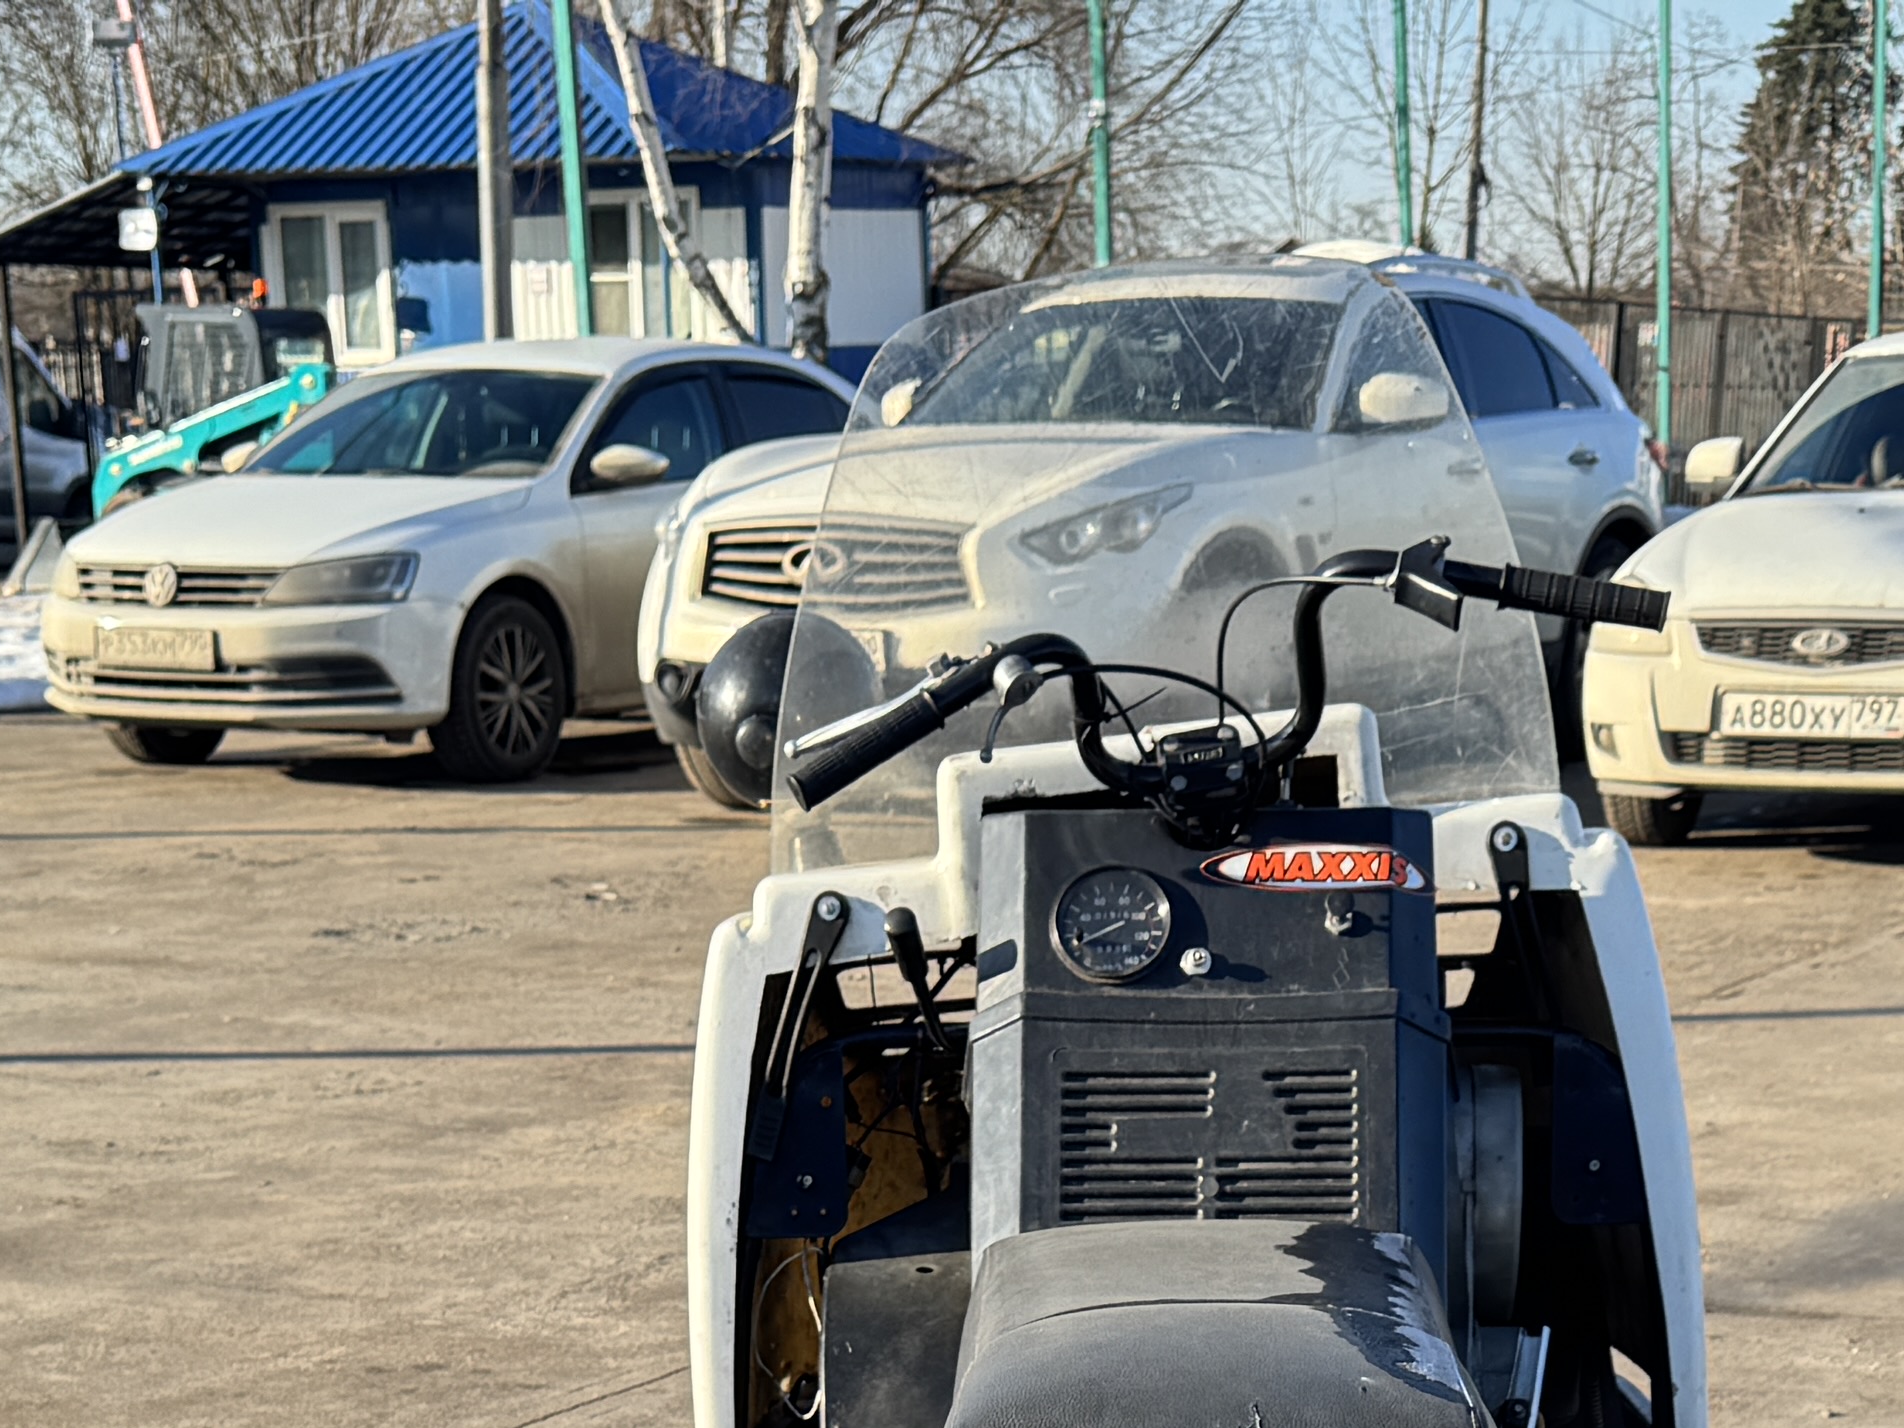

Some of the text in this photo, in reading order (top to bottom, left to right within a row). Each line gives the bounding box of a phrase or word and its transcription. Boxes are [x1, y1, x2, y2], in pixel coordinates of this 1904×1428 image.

[1730, 698, 1899, 730] А880ХУ 797
[1243, 851, 1409, 886] MAXXIS
